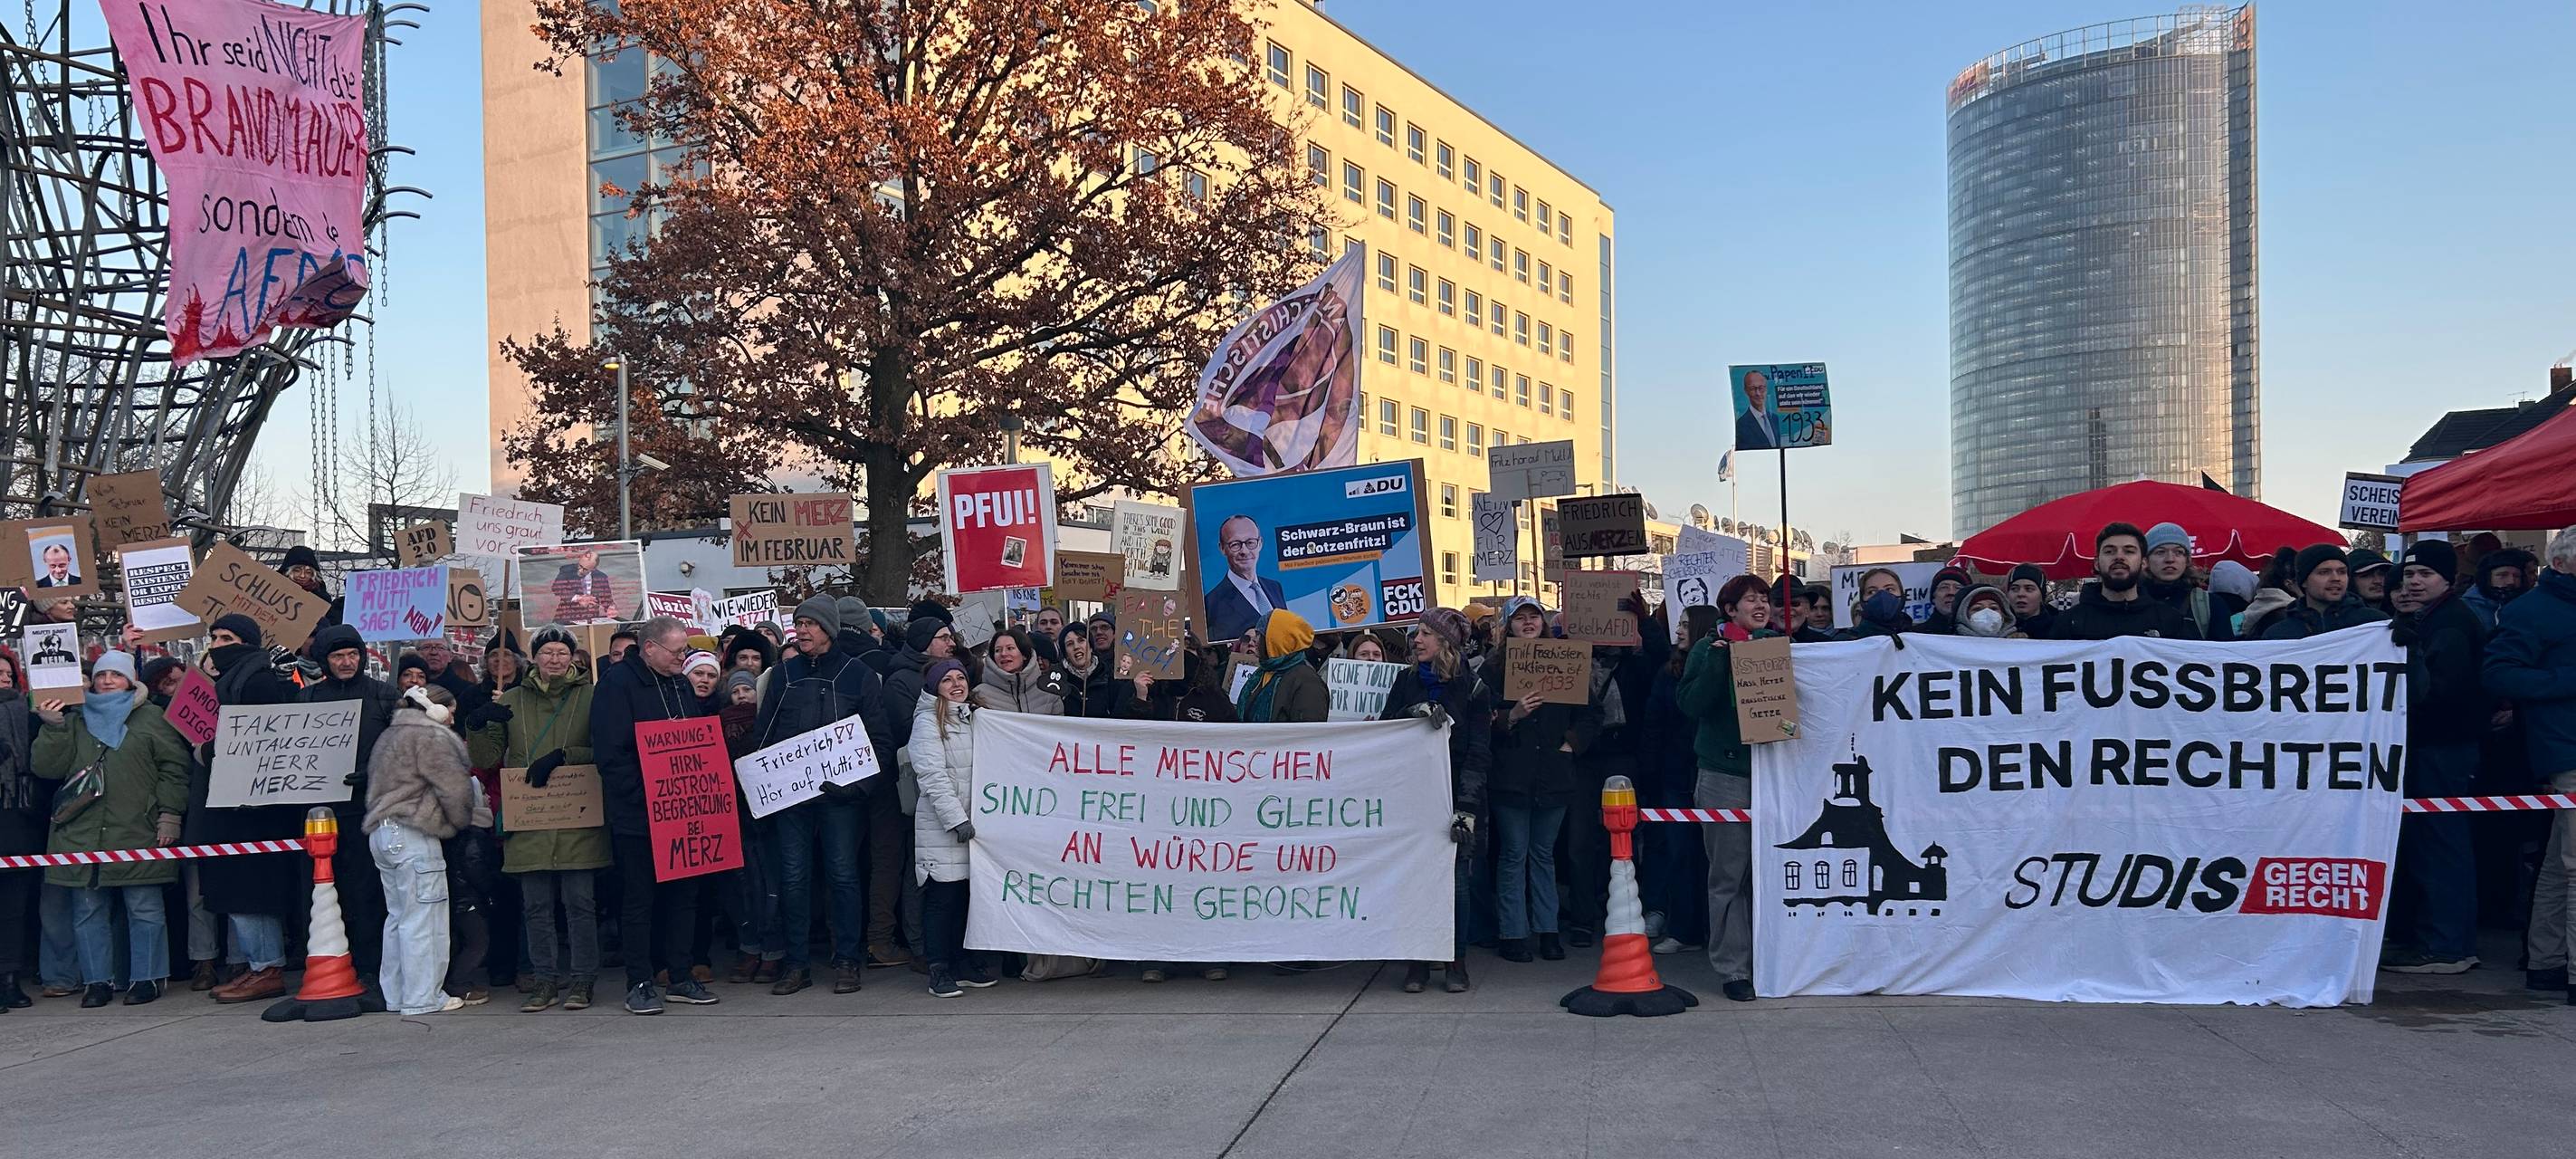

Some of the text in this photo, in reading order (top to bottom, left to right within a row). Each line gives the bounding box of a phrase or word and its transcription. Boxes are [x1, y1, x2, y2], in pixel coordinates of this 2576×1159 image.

[139, 2, 357, 100] Ihr seid NICHT die
[140, 77, 367, 177] BRANDMAUER
[1783, 411, 1825, 443] 1933
[1492, 455, 1511, 467] Fritz
[2349, 485, 2399, 505] SCHEIS
[104, 515, 131, 528] KEIN
[469, 496, 543, 522] Friedrich
[749, 499, 849, 525] KEIN MERZ
[955, 489, 1036, 530] PFUI!
[1563, 501, 1637, 522] FRIEDRICH
[121, 522, 170, 543] MERZ!
[407, 527, 436, 546] AFD
[477, 520, 544, 540] uns graut
[1281, 516, 1405, 541] Schwarz-Braun ist
[1565, 529, 1644, 551] AUSMERZEN
[475, 538, 502, 552] vor
[740, 538, 846, 563] IM FEBRUAR
[1283, 545, 1307, 558] der
[129, 562, 188, 577] RESPECT
[1476, 550, 1513, 567] MERZ
[129, 572, 190, 587] EXISTENCE
[220, 562, 303, 621] SCHLUSS
[356, 567, 438, 592] FRIEDRICH
[1383, 582, 1423, 601] FCK
[131, 588, 148, 597] OR
[361, 589, 410, 610] MUTTI
[650, 597, 692, 612] Nazis
[712, 589, 778, 618] NIE WIEDER
[1124, 595, 1160, 615] EAT
[231, 594, 253, 611] MIT
[253, 607, 278, 626] DEM
[1386, 598, 1425, 616] CDU
[358, 604, 444, 637] SAGT NEIN!
[1139, 618, 1179, 637] THE
[1121, 629, 1175, 672] RICH
[1509, 643, 1531, 660] mit
[1331, 663, 1363, 685] KEINE
[1567, 662, 1581, 675] ist
[1539, 675, 1575, 692] 1933
[1873, 657, 2407, 722] KEIN FUSSBREIT
[1330, 686, 1349, 712] FÜR
[229, 710, 357, 737] FAKTISCH
[227, 734, 353, 756] UNTAUGLICH
[644, 724, 714, 749] WARNUNG!
[257, 754, 319, 773] HERR
[670, 753, 709, 775] HIRN-
[1048, 742, 1332, 783] ALLE MENSCHEN
[1939, 738, 2403, 793] DEN RECHTEN
[250, 774, 329, 797] MERZ
[655, 771, 726, 798] ZUSTROM-
[757, 781, 783, 806] Hör
[791, 766, 814, 791] auf
[653, 793, 731, 822] BEGRENZUNG
[980, 782, 1384, 829] SIND FREI UND GLEICH
[687, 820, 703, 836] BEI
[670, 834, 724, 869] MERZ
[1061, 830, 1336, 873] AN WÜRDE UND
[2005, 853, 2247, 913] STUDIS
[2264, 862, 2368, 889] GEGEN
[1002, 868, 1368, 921] RECHTEN GEBOREN.
[2266, 885, 2369, 911] RECHT
